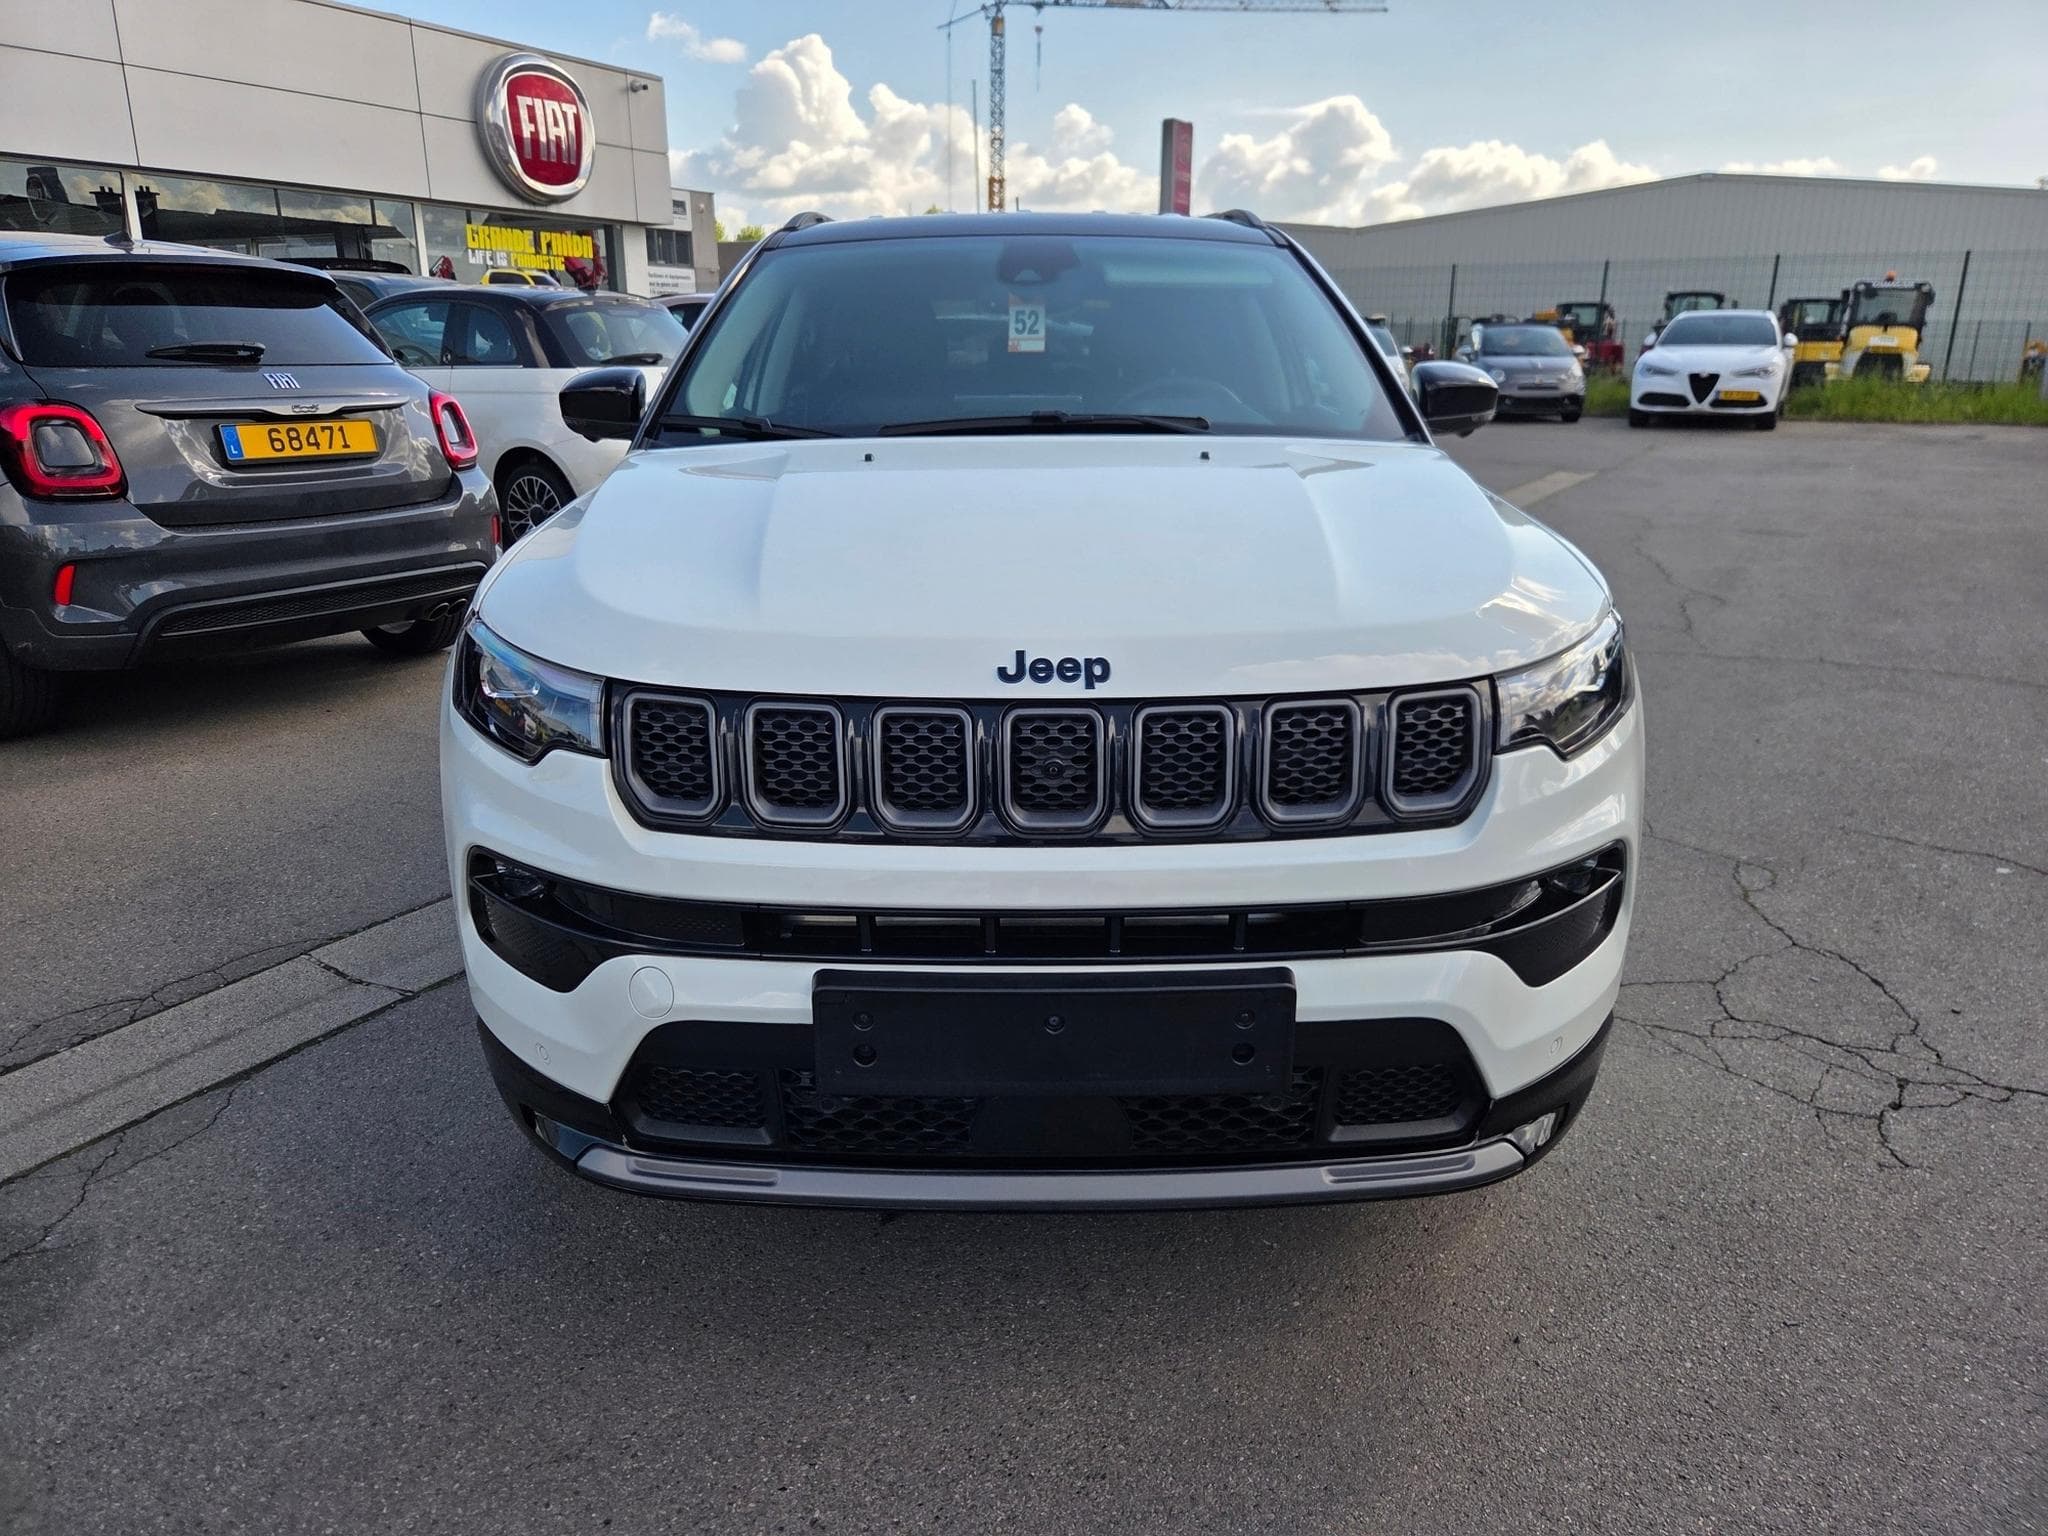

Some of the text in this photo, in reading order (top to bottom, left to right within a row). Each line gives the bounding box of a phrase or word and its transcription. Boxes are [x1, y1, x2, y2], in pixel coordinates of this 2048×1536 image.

[516, 94, 577, 166] FIAT
[466, 223, 593, 259] GRANDE PANDA
[468, 249, 493, 265] LIFE
[496, 251, 508, 267] IS
[1014, 310, 1040, 335] 52
[263, 373, 300, 389] FIAT
[267, 425, 350, 452] 68471
[997, 650, 1111, 690] Jeep
